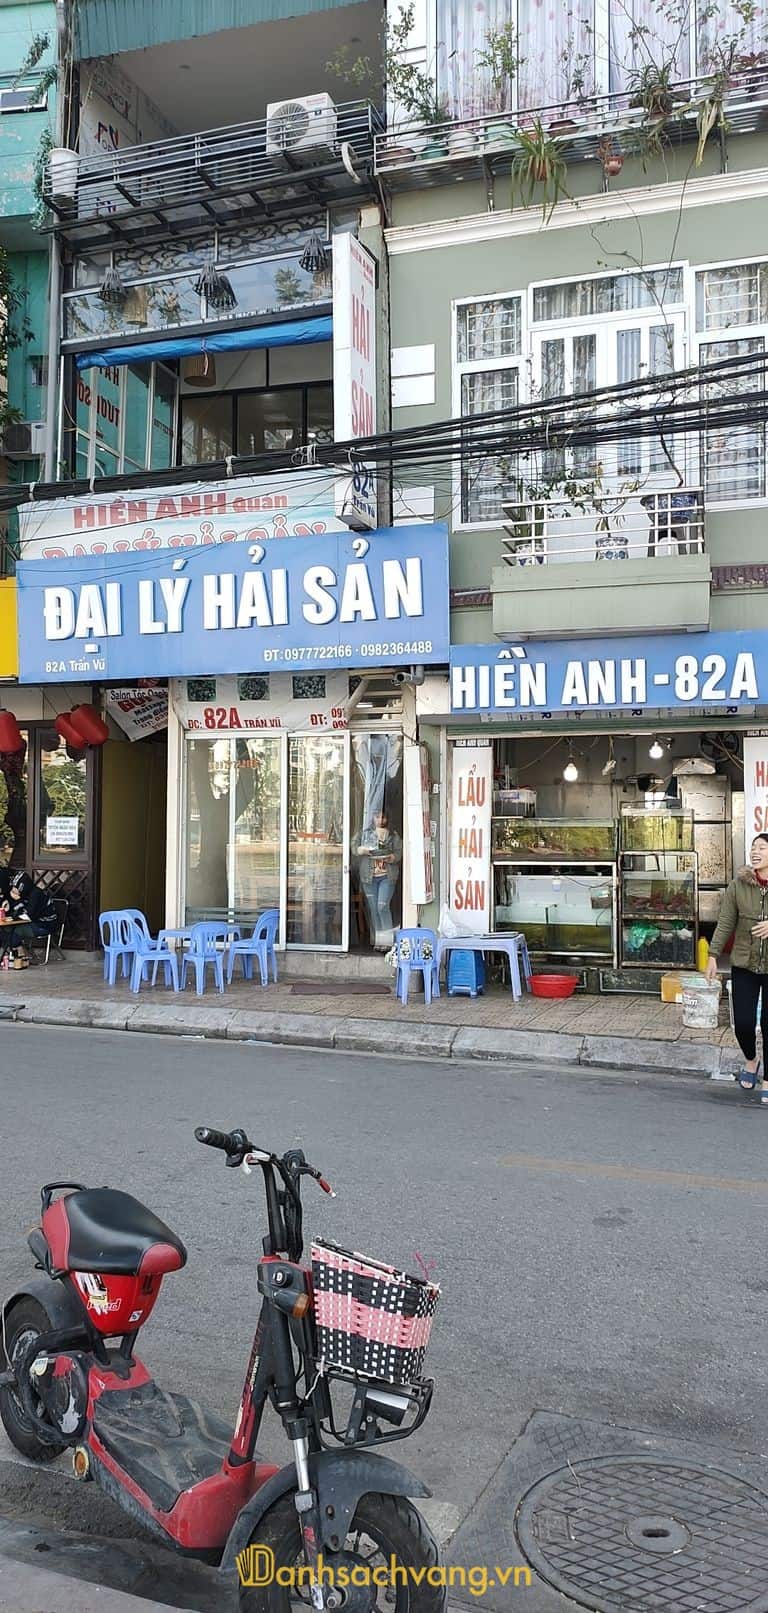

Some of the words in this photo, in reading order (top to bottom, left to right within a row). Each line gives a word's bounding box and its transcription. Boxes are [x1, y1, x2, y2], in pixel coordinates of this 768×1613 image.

[155, 492, 227, 518] ANH
[44, 582, 121, 653] ĐẠI
[139, 559, 190, 634] LÝ
[203, 545, 288, 630] HẢI
[303, 538, 424, 625] SẢN
[45, 661, 67, 673] 82A
[452, 646, 547, 708] HIỀN
[204, 707, 242, 729] 82A
[311, 713, 327, 726] ĐT:
[458, 764, 486, 807] LẨU
[458, 814, 483, 858] HẢI
[454, 866, 486, 910] SẢN
